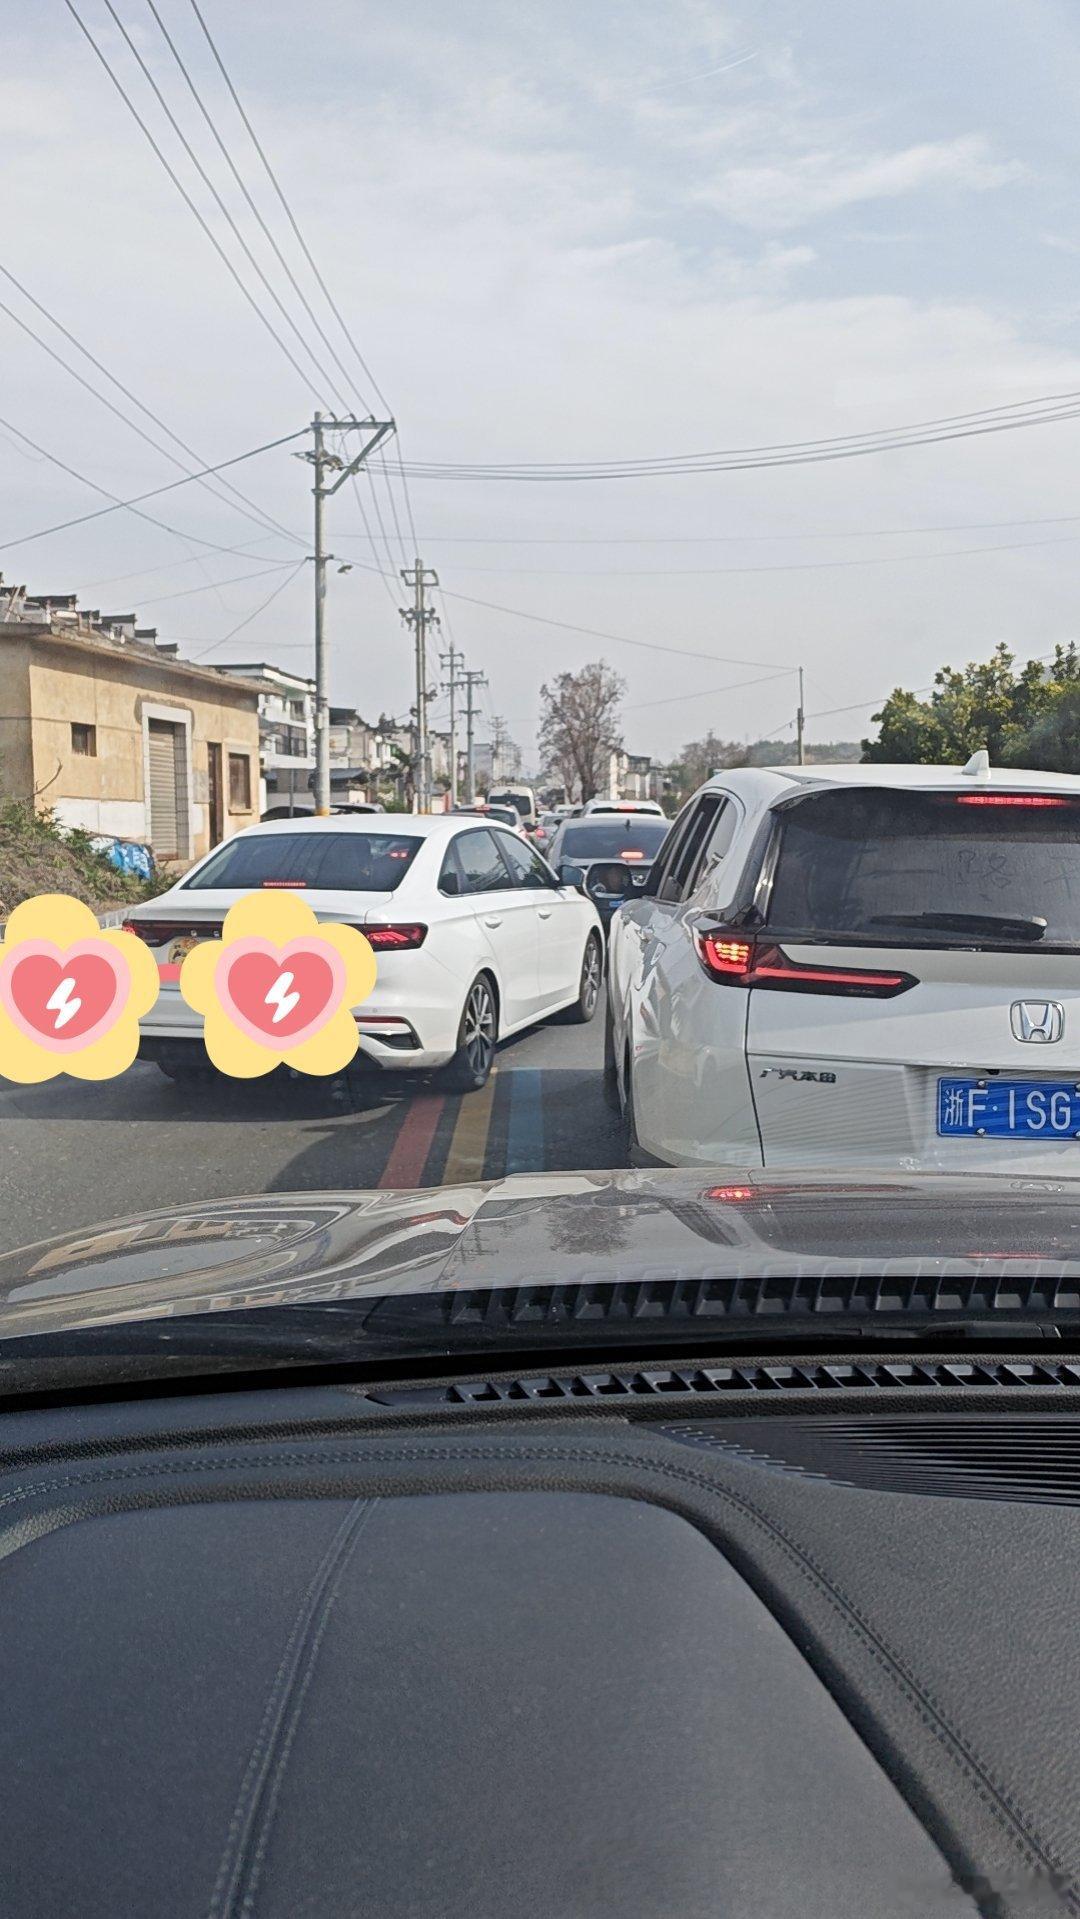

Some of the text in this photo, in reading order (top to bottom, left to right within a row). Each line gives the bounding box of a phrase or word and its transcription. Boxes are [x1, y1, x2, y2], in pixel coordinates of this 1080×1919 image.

[759, 1068, 837, 1084] 广汽本田
[944, 1087, 1080, 1131] 浙F·1SG
